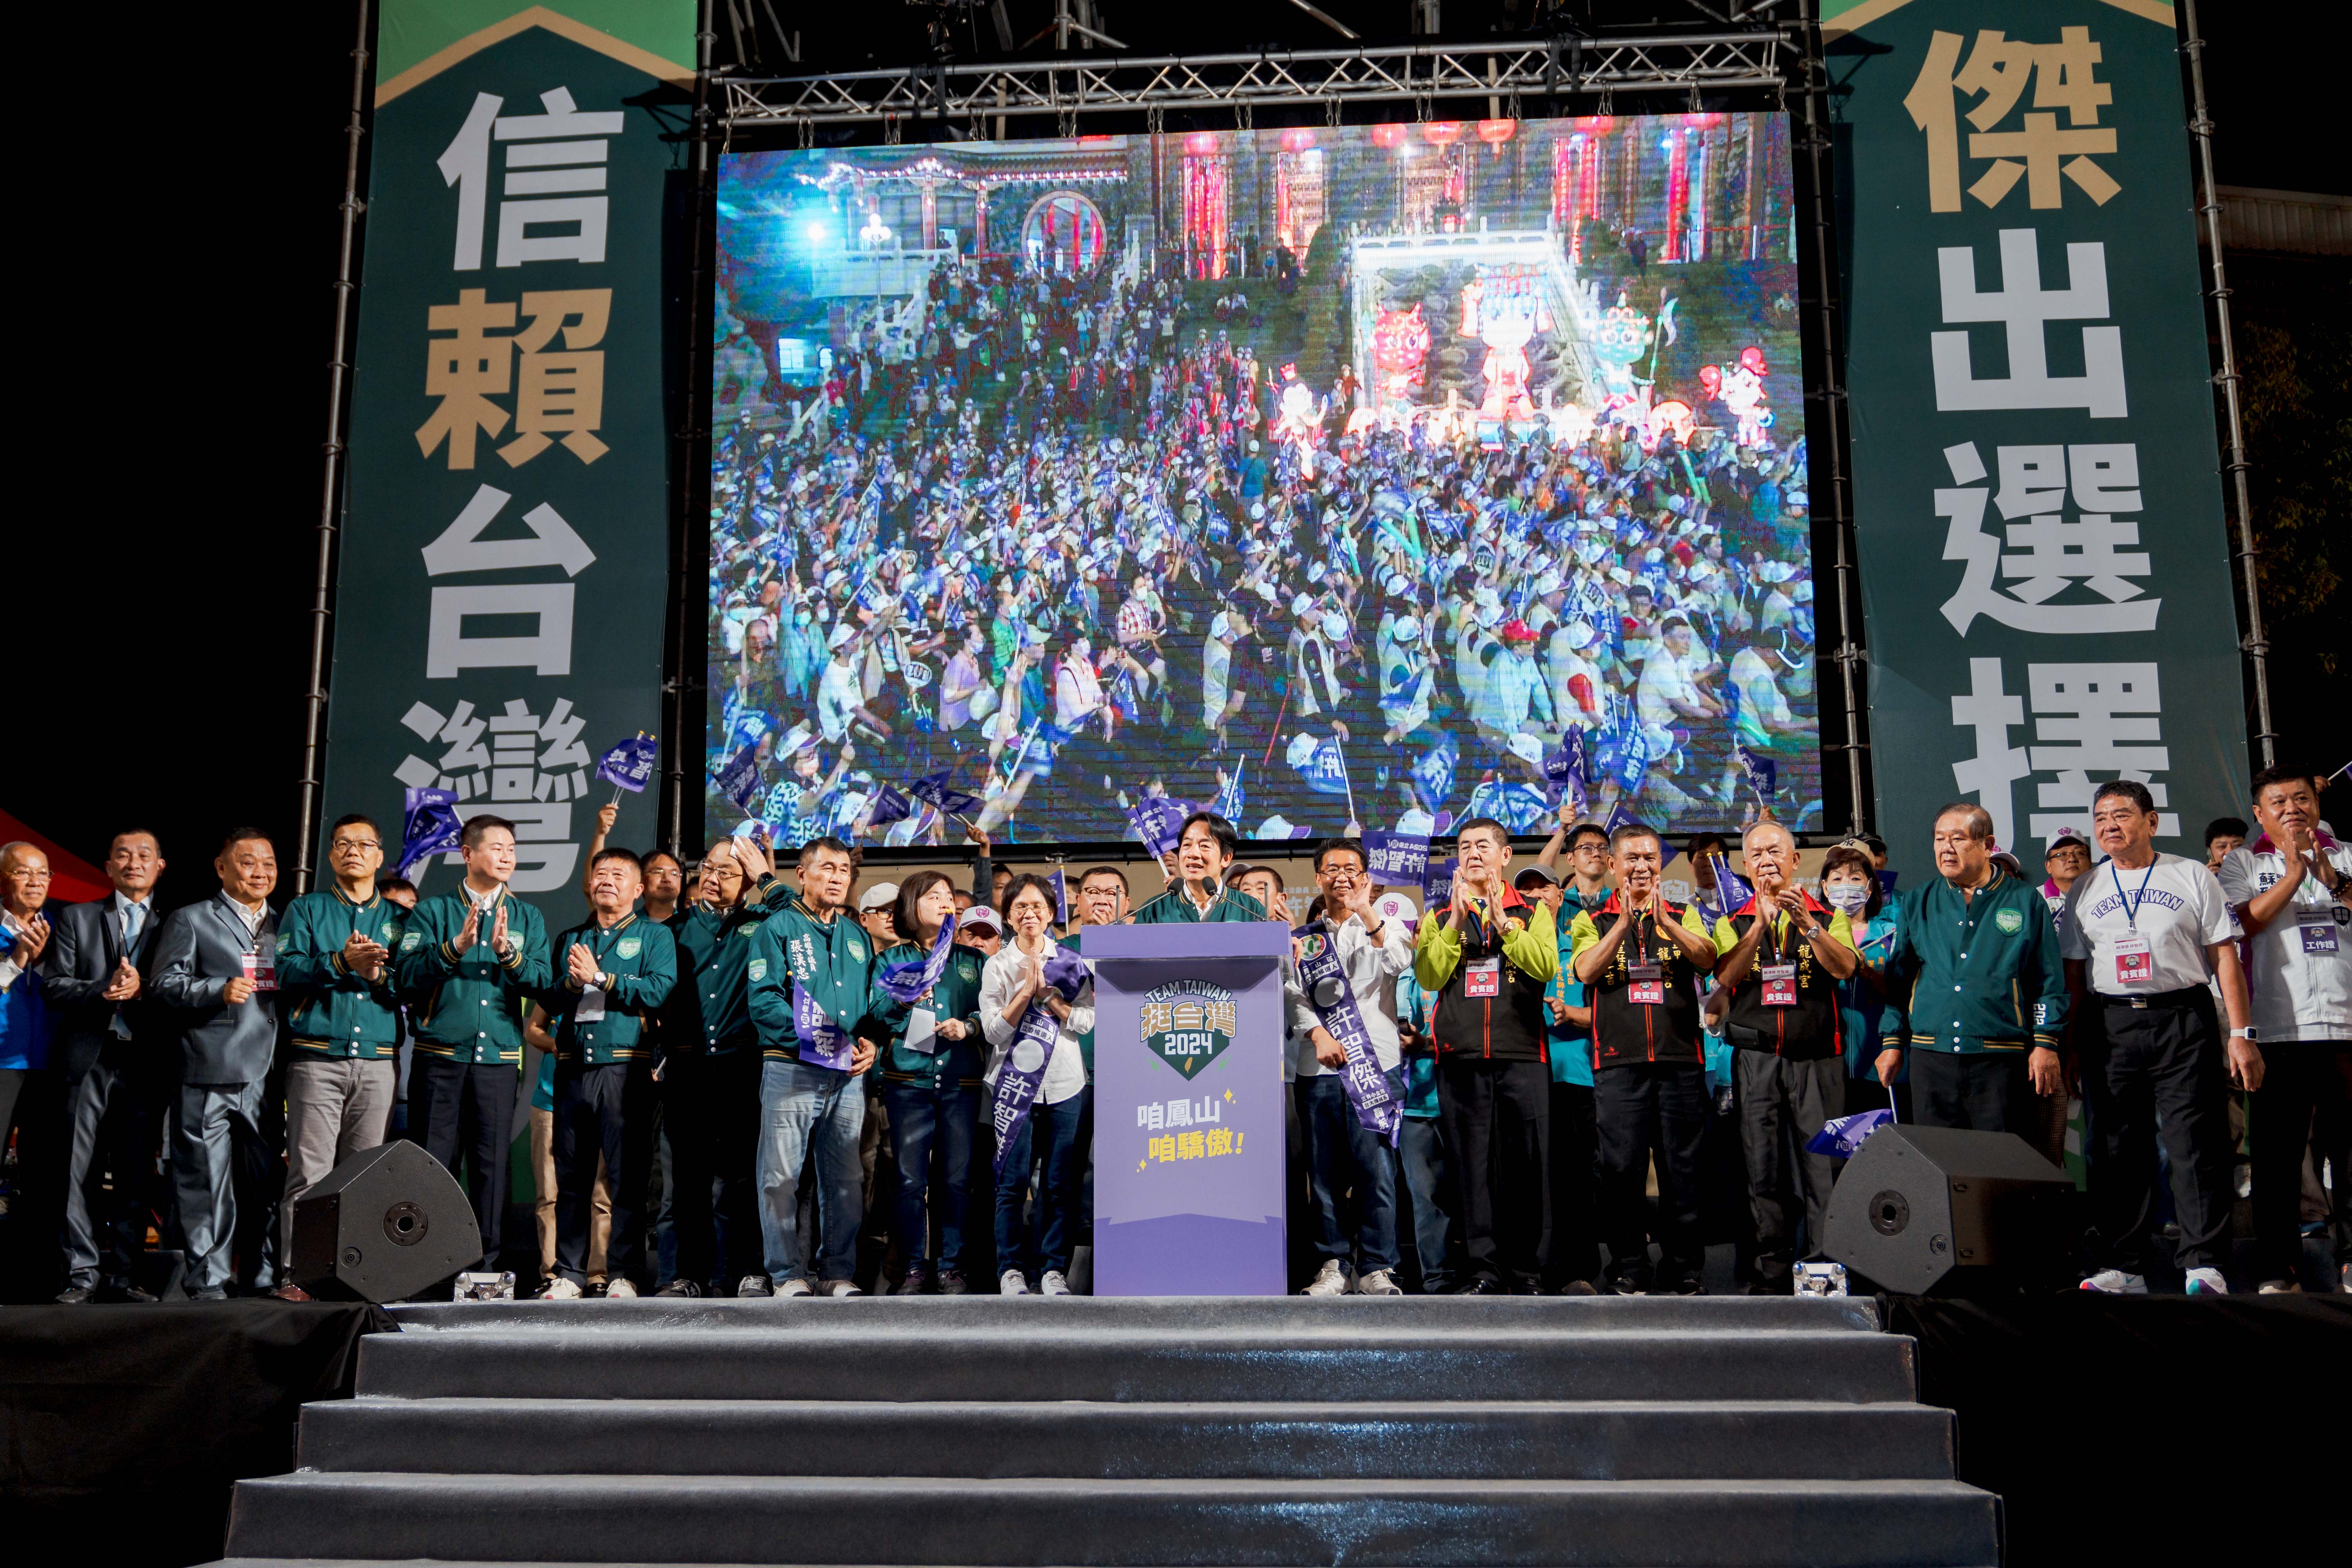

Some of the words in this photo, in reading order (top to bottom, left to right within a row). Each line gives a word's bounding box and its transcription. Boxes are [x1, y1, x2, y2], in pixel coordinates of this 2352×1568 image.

[1904, 26, 2180, 862] 傑出選擇
[393, 86, 624, 892] 信賴台灣
[2091, 892, 2125, 918] TEAM
[790, 940, 809, 980] 張漢忠
[803, 933, 816, 971] 高雄市議員
[1616, 940, 1627, 982] 主任委員
[2306, 940, 2335, 949] 工作證
[1657, 947, 1673, 989] 龍成宮
[1797, 944, 1812, 988] 龍成宮
[2120, 968, 2147, 979] 貴賓證
[1144, 981, 1181, 1002] TEAM
[1183, 979, 1232, 1001] TAIWAN
[1470, 984, 1494, 993] 貴賓證
[1633, 991, 1659, 1000] 貴賓證
[1766, 993, 1792, 1001] 貴賓證
[1022, 1025, 1052, 1042] 立委候選人
[1140, 1000, 1237, 1042] 挺台灣
[1165, 1033, 1212, 1054] 2024
[1326, 1005, 1381, 1094] 許智傑
[1138, 1096, 1220, 1130] 咱鳳山
[1149, 1127, 1244, 1163] 咱驕傲!
